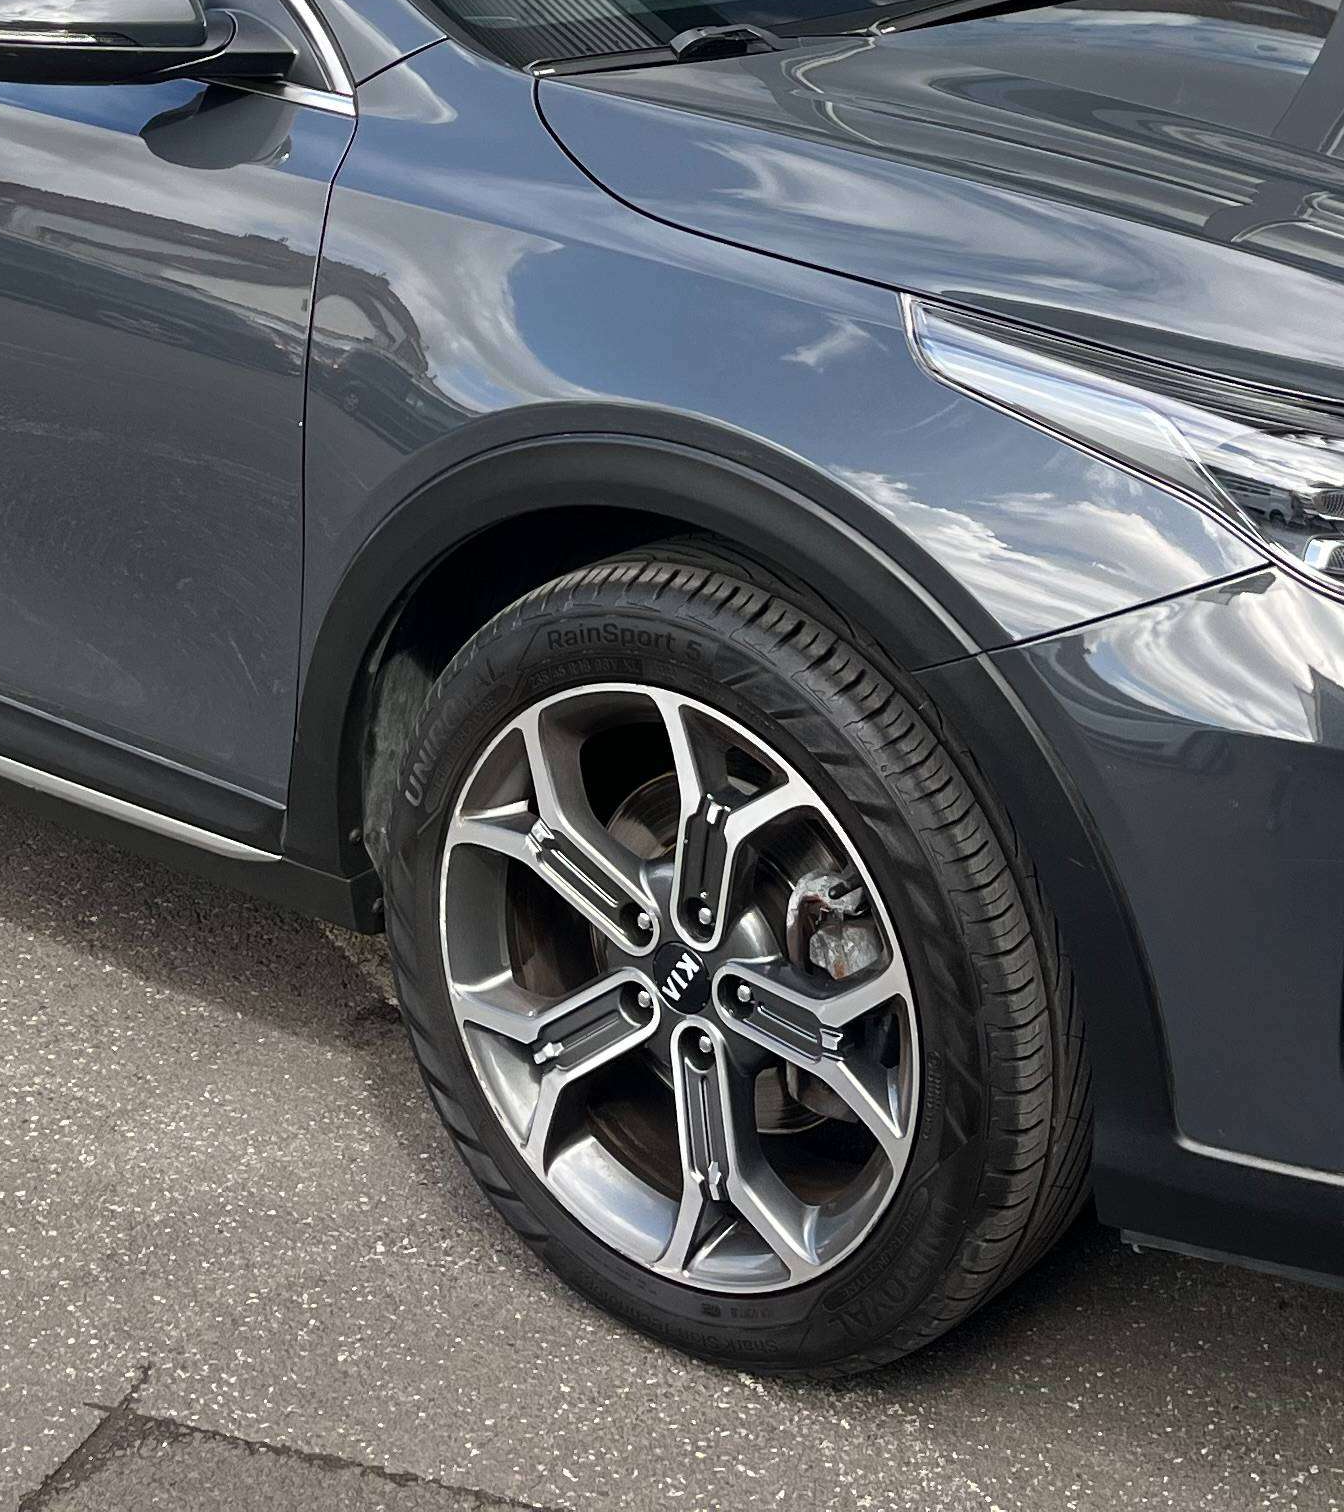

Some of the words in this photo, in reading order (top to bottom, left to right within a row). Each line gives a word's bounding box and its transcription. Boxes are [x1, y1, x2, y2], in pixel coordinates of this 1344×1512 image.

[547, 622, 676, 653] RainSport
[685, 640, 703, 662] 5
[661, 953, 700, 1001] KIA
